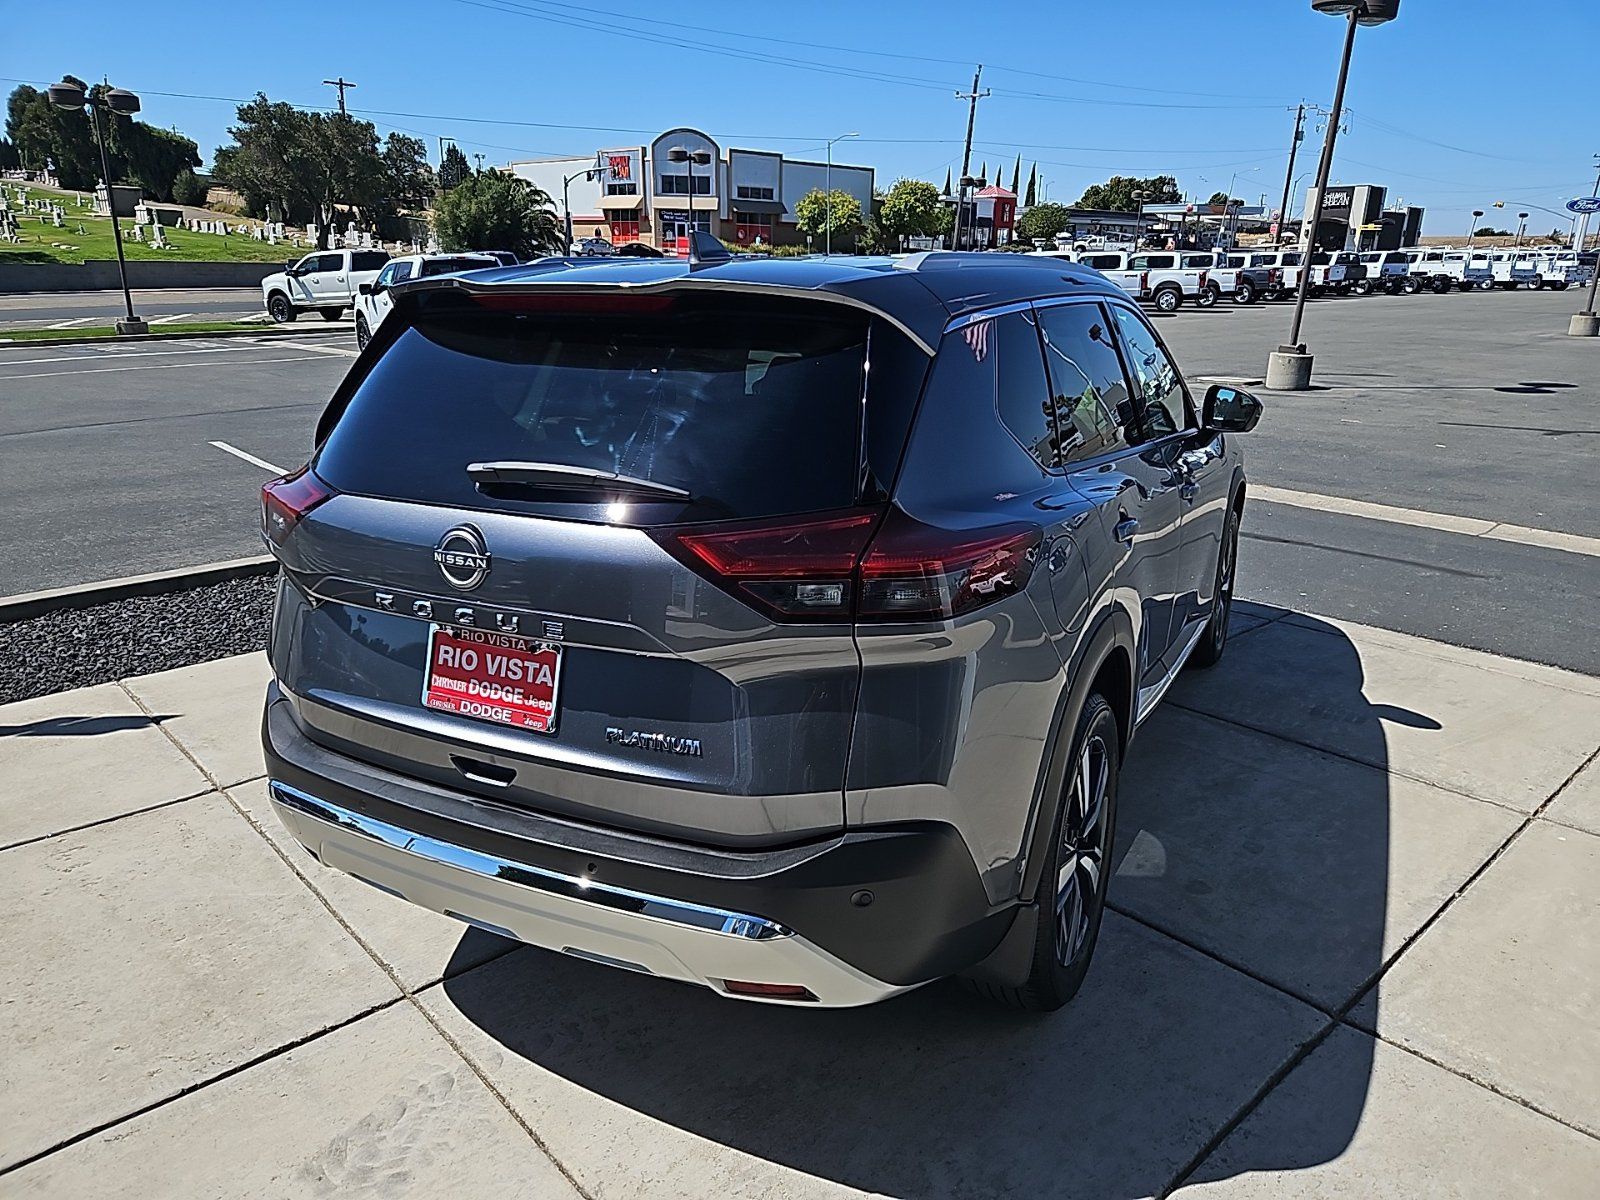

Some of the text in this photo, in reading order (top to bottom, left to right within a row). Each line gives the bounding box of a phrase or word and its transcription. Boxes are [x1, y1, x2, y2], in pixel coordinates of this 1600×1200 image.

[1574, 200, 1600, 209] Ford
[434, 552, 487, 568] NISSAN
[375, 592, 564, 640] ROGUE
[461, 629, 527, 651] RIO VISTA
[438, 645, 553, 687] RIO VISTA
[432, 674, 553, 712] CHRYSLER DODGE Jeep
[460, 700, 513, 722] DODGE
[524, 717, 543, 729] Jeep
[606, 727, 702, 756] PLATINUM
